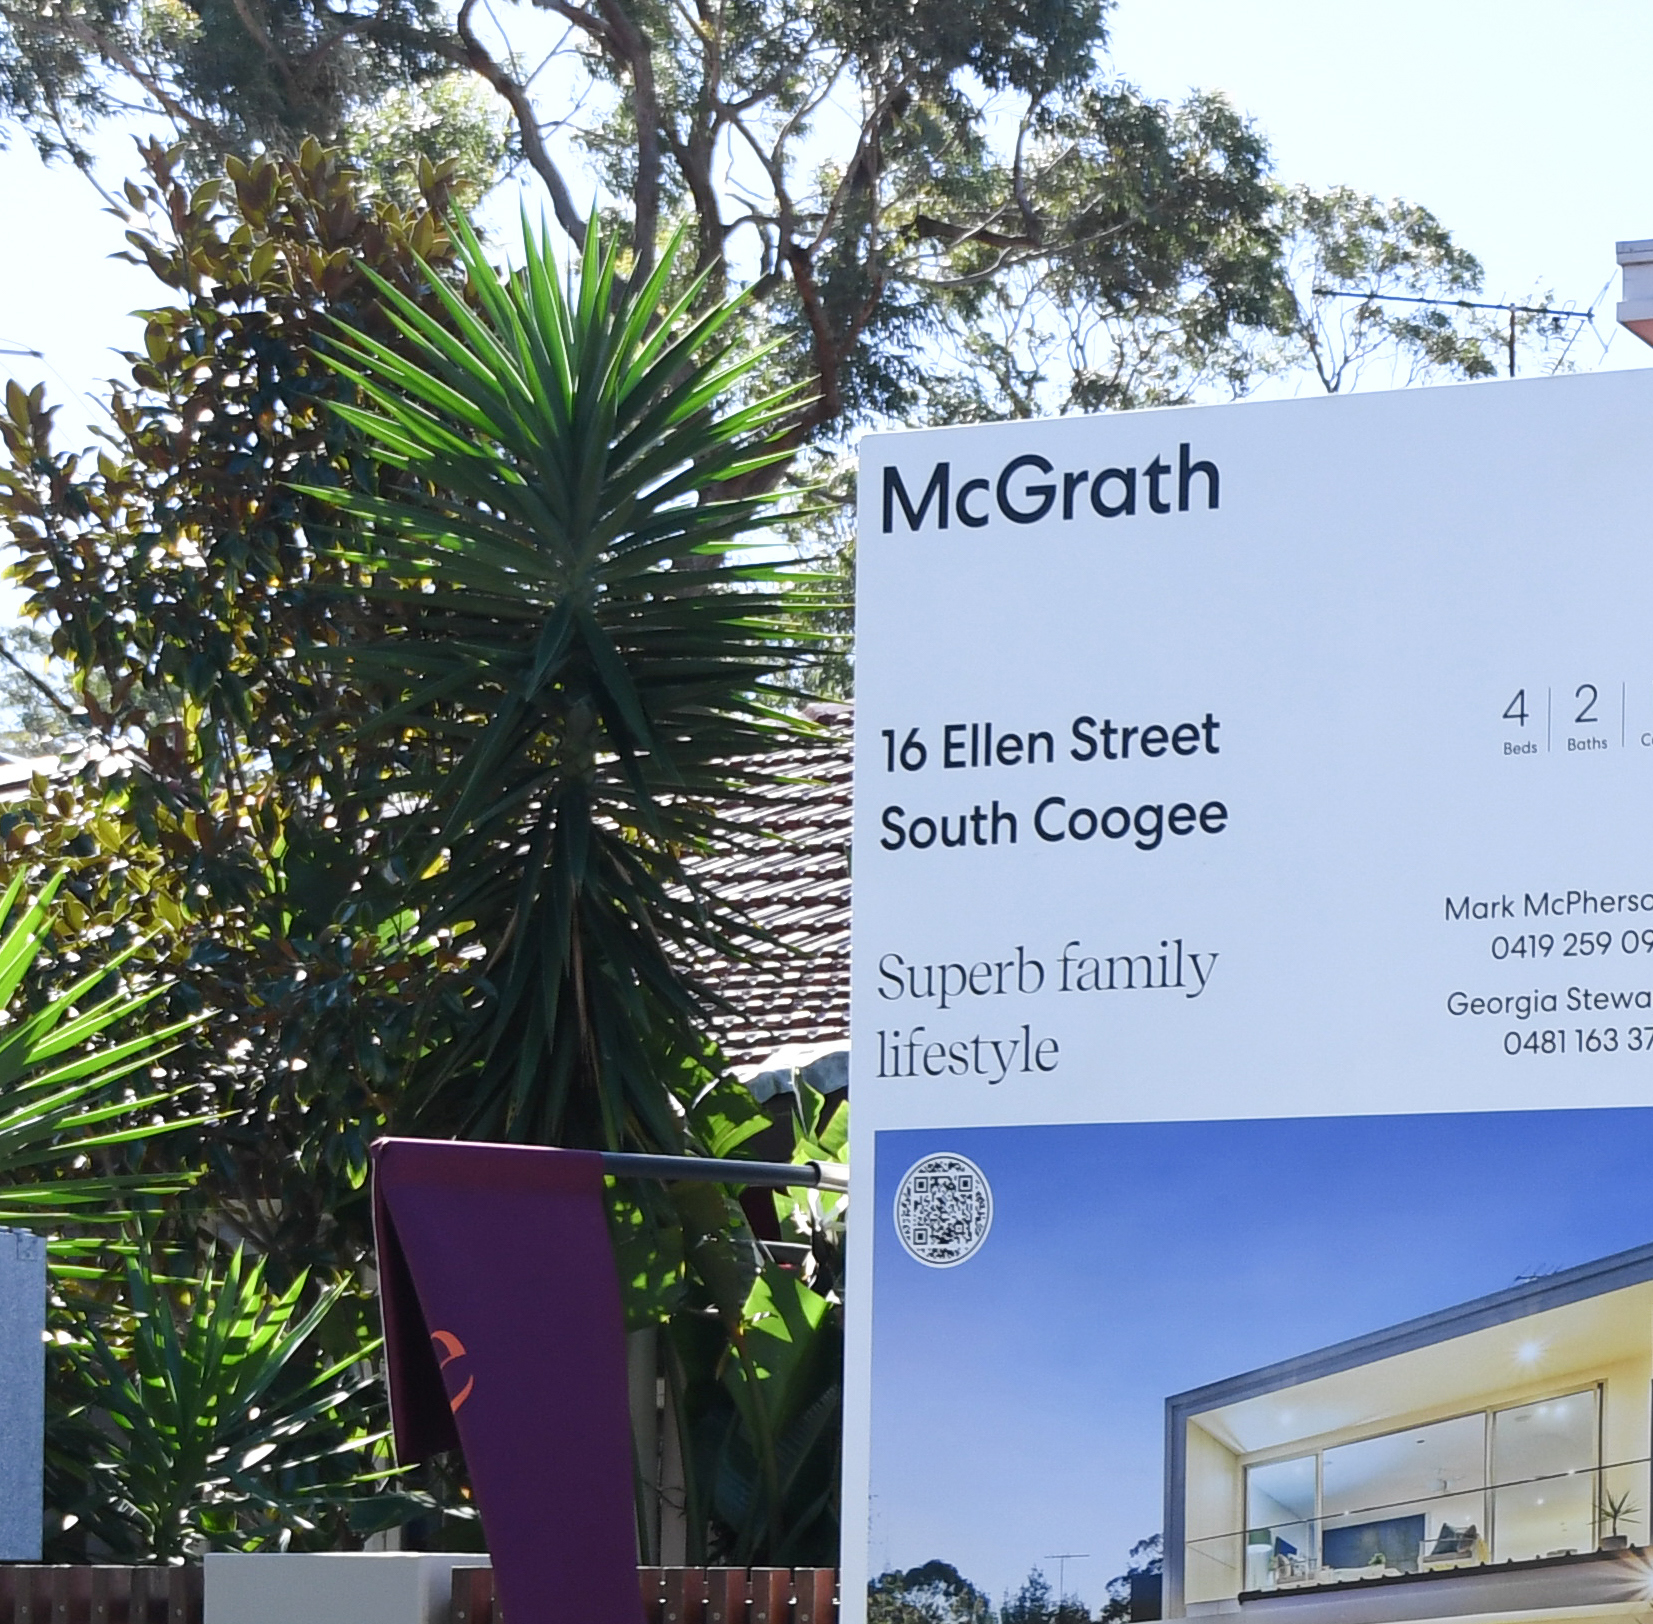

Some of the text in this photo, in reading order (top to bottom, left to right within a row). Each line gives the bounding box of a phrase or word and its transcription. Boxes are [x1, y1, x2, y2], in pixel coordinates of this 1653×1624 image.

[882, 442, 1220, 534] McGrath
[1502, 689, 1529, 727] 4
[1574, 683, 1598, 723] 2
[881, 713, 1221, 773] 16 Ellen Street
[1503, 740, 1538, 756] Beds
[1567, 736, 1608, 752] Baths
[880, 796, 1229, 851] South Coogee
[1445, 894, 1515, 921] Mark
[1491, 933, 1555, 960] 0419
[1562, 931, 1612, 957] 259
[877, 938, 1219, 1010] Superb family
[1447, 989, 1557, 1020] Georgia
[877, 1024, 1059, 1085] lifestyle
[1503, 1029, 1566, 1056] 0481
[1574, 1027, 1619, 1053] 163
